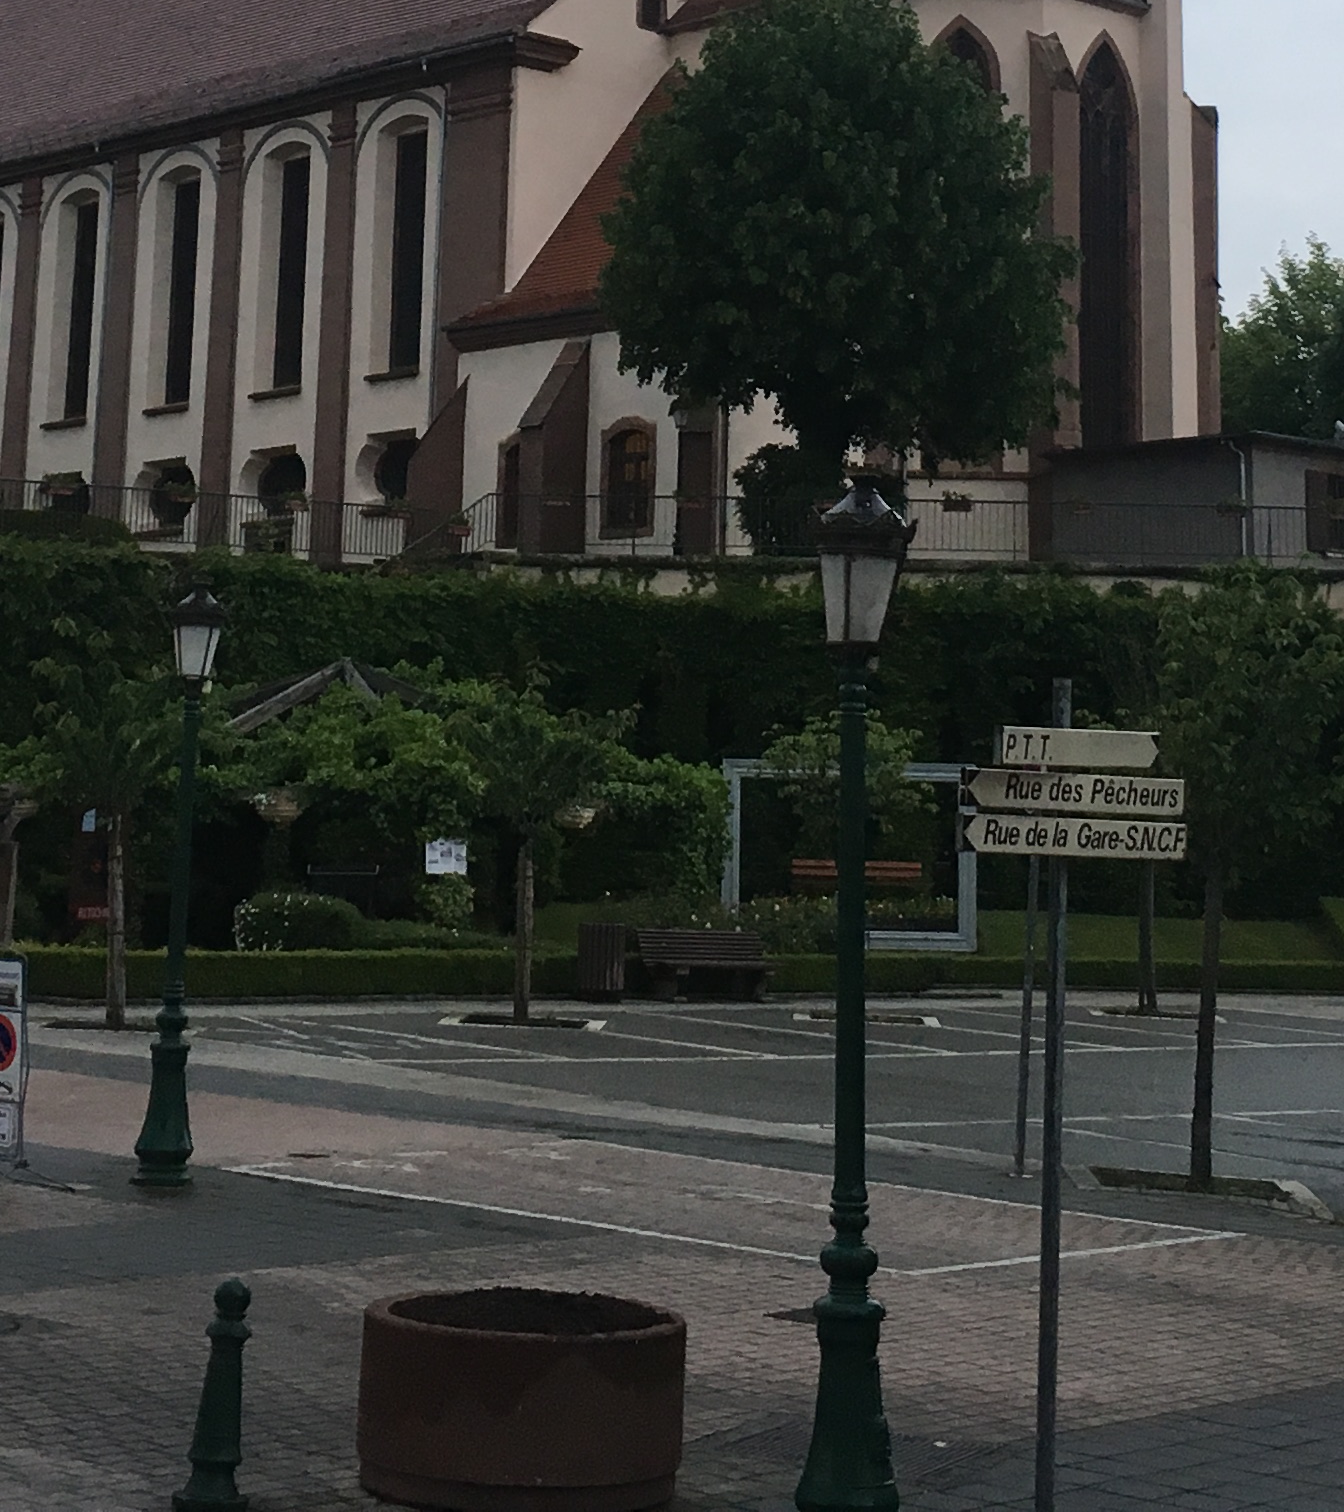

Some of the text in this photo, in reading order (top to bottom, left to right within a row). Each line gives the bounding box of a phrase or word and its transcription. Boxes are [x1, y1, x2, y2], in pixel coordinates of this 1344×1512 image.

[1005, 734, 1052, 761] P.T.T.
[1005, 772, 1179, 808] Rue des Pêcheurs
[983, 819, 1020, 846] Rue
[1025, 821, 1048, 847] de
[1052, 821, 1068, 847] la
